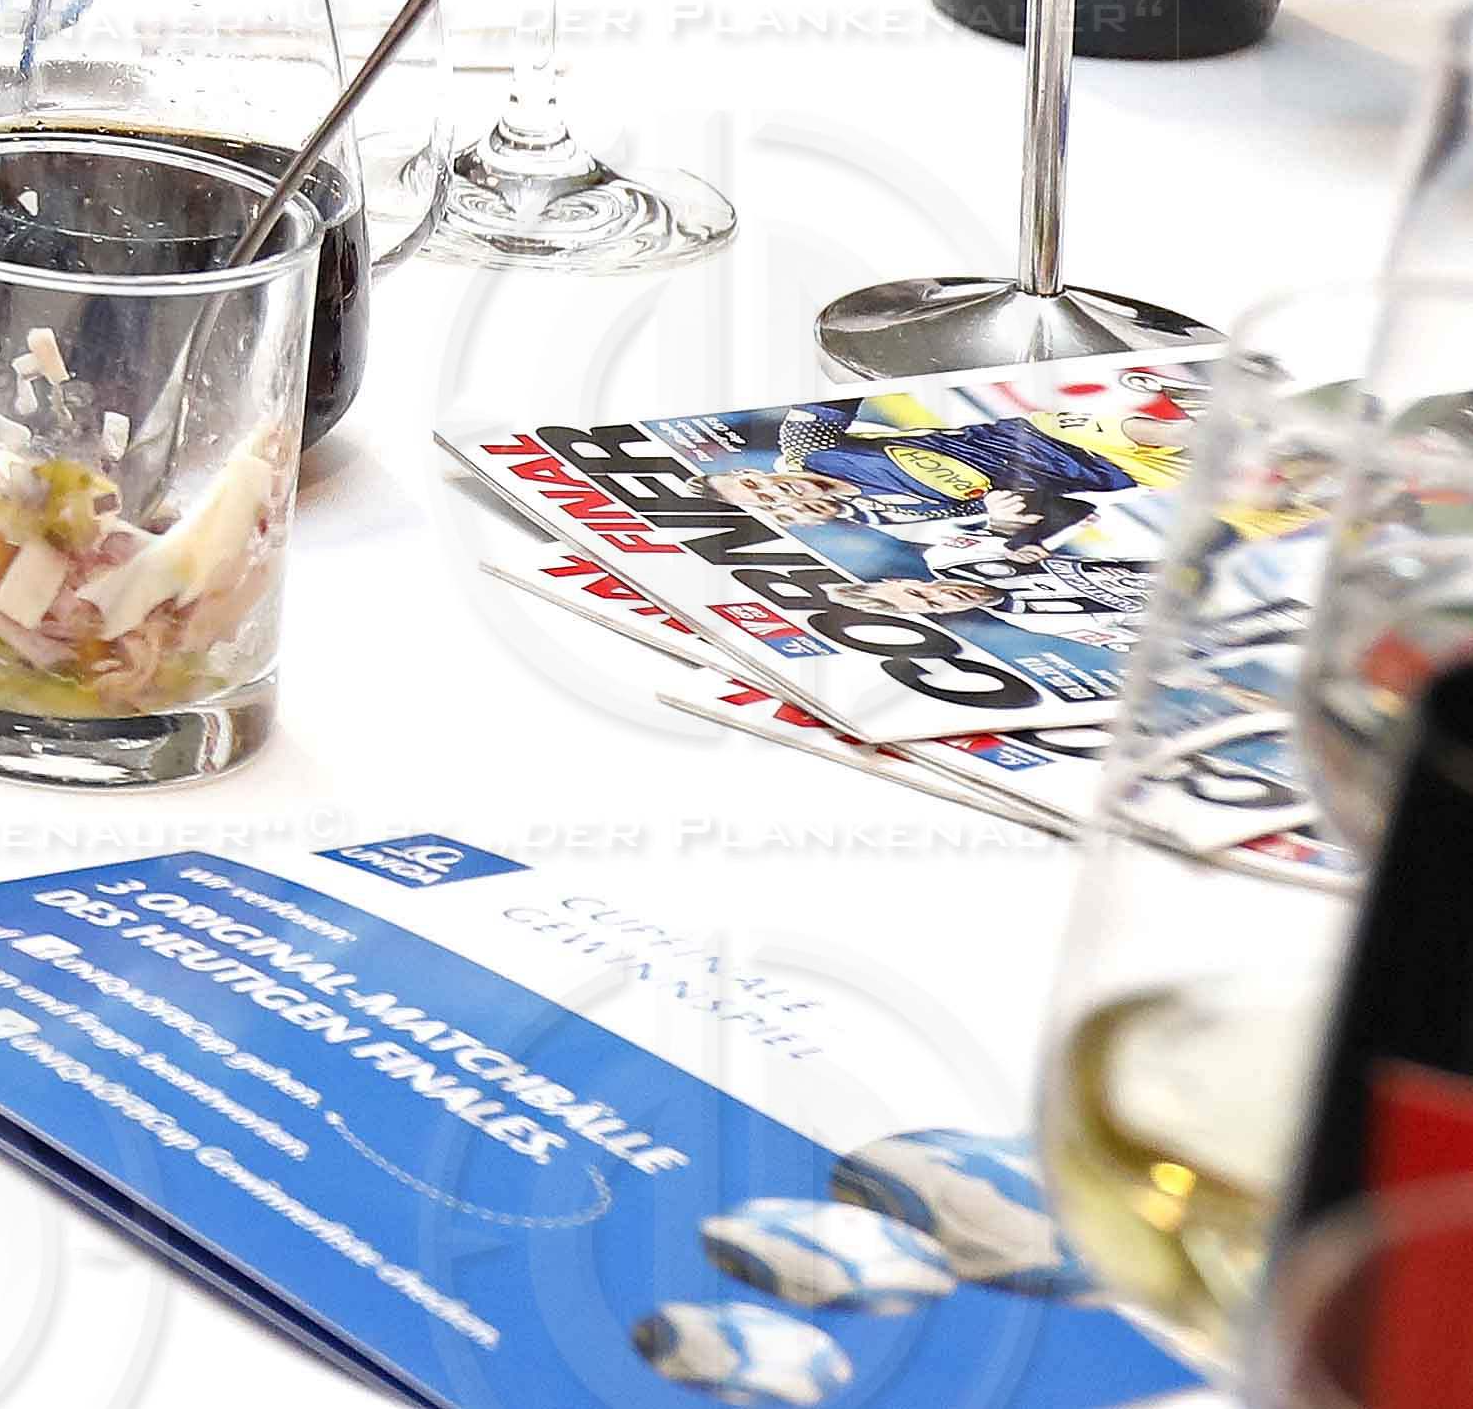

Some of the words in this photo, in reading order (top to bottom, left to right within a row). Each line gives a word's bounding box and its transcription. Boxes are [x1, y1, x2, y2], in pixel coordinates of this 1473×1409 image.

[480, 434, 686, 553] FINAL
[900, 450, 973, 492] RAUCH
[535, 423, 1044, 710] CORNER
[96, 878, 148, 896] 3
[339, 846, 444, 886] UNIQA
[32, 888, 141, 927] DES
[122, 924, 372, 1044] HEUTIGEN
